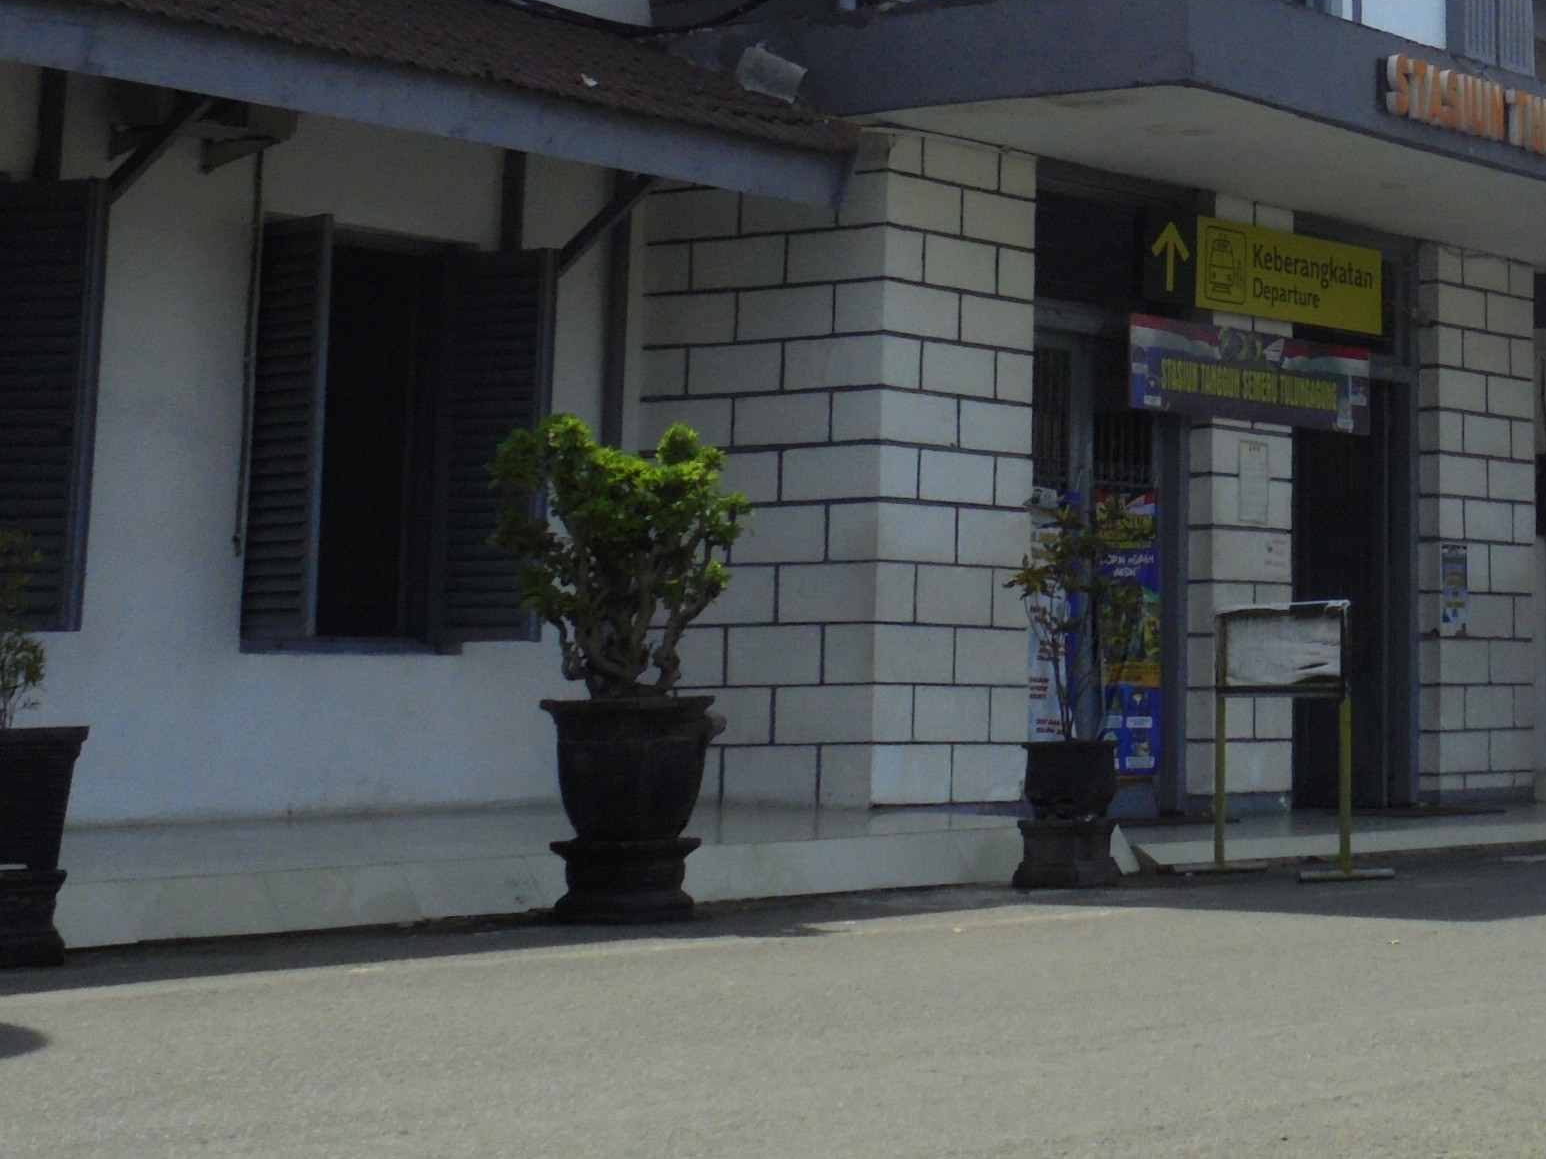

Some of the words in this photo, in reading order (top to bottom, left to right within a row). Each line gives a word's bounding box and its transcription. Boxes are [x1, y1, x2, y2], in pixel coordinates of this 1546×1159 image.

[1386, 53, 1505, 141] STASIUN
[1253, 243, 1373, 289] Keberangkatan
[1253, 277, 1320, 308] Departure
[1161, 357, 1199, 393] STASIUN
